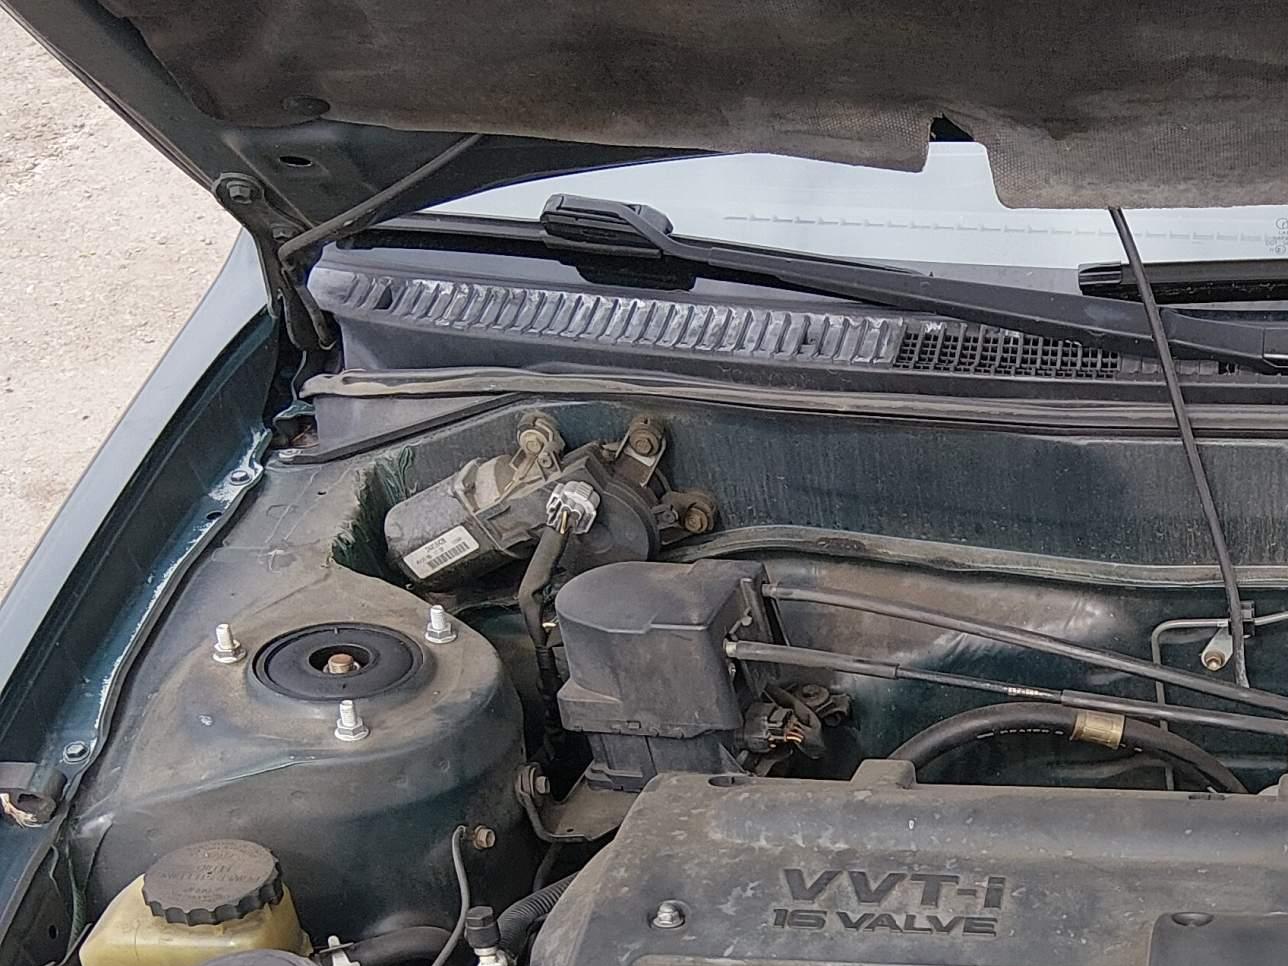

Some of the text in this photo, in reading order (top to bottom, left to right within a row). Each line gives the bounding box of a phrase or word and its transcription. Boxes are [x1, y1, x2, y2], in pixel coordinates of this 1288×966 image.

[784, 868, 1006, 909] VVT-i
[773, 908, 998, 936] 16 VALVE
